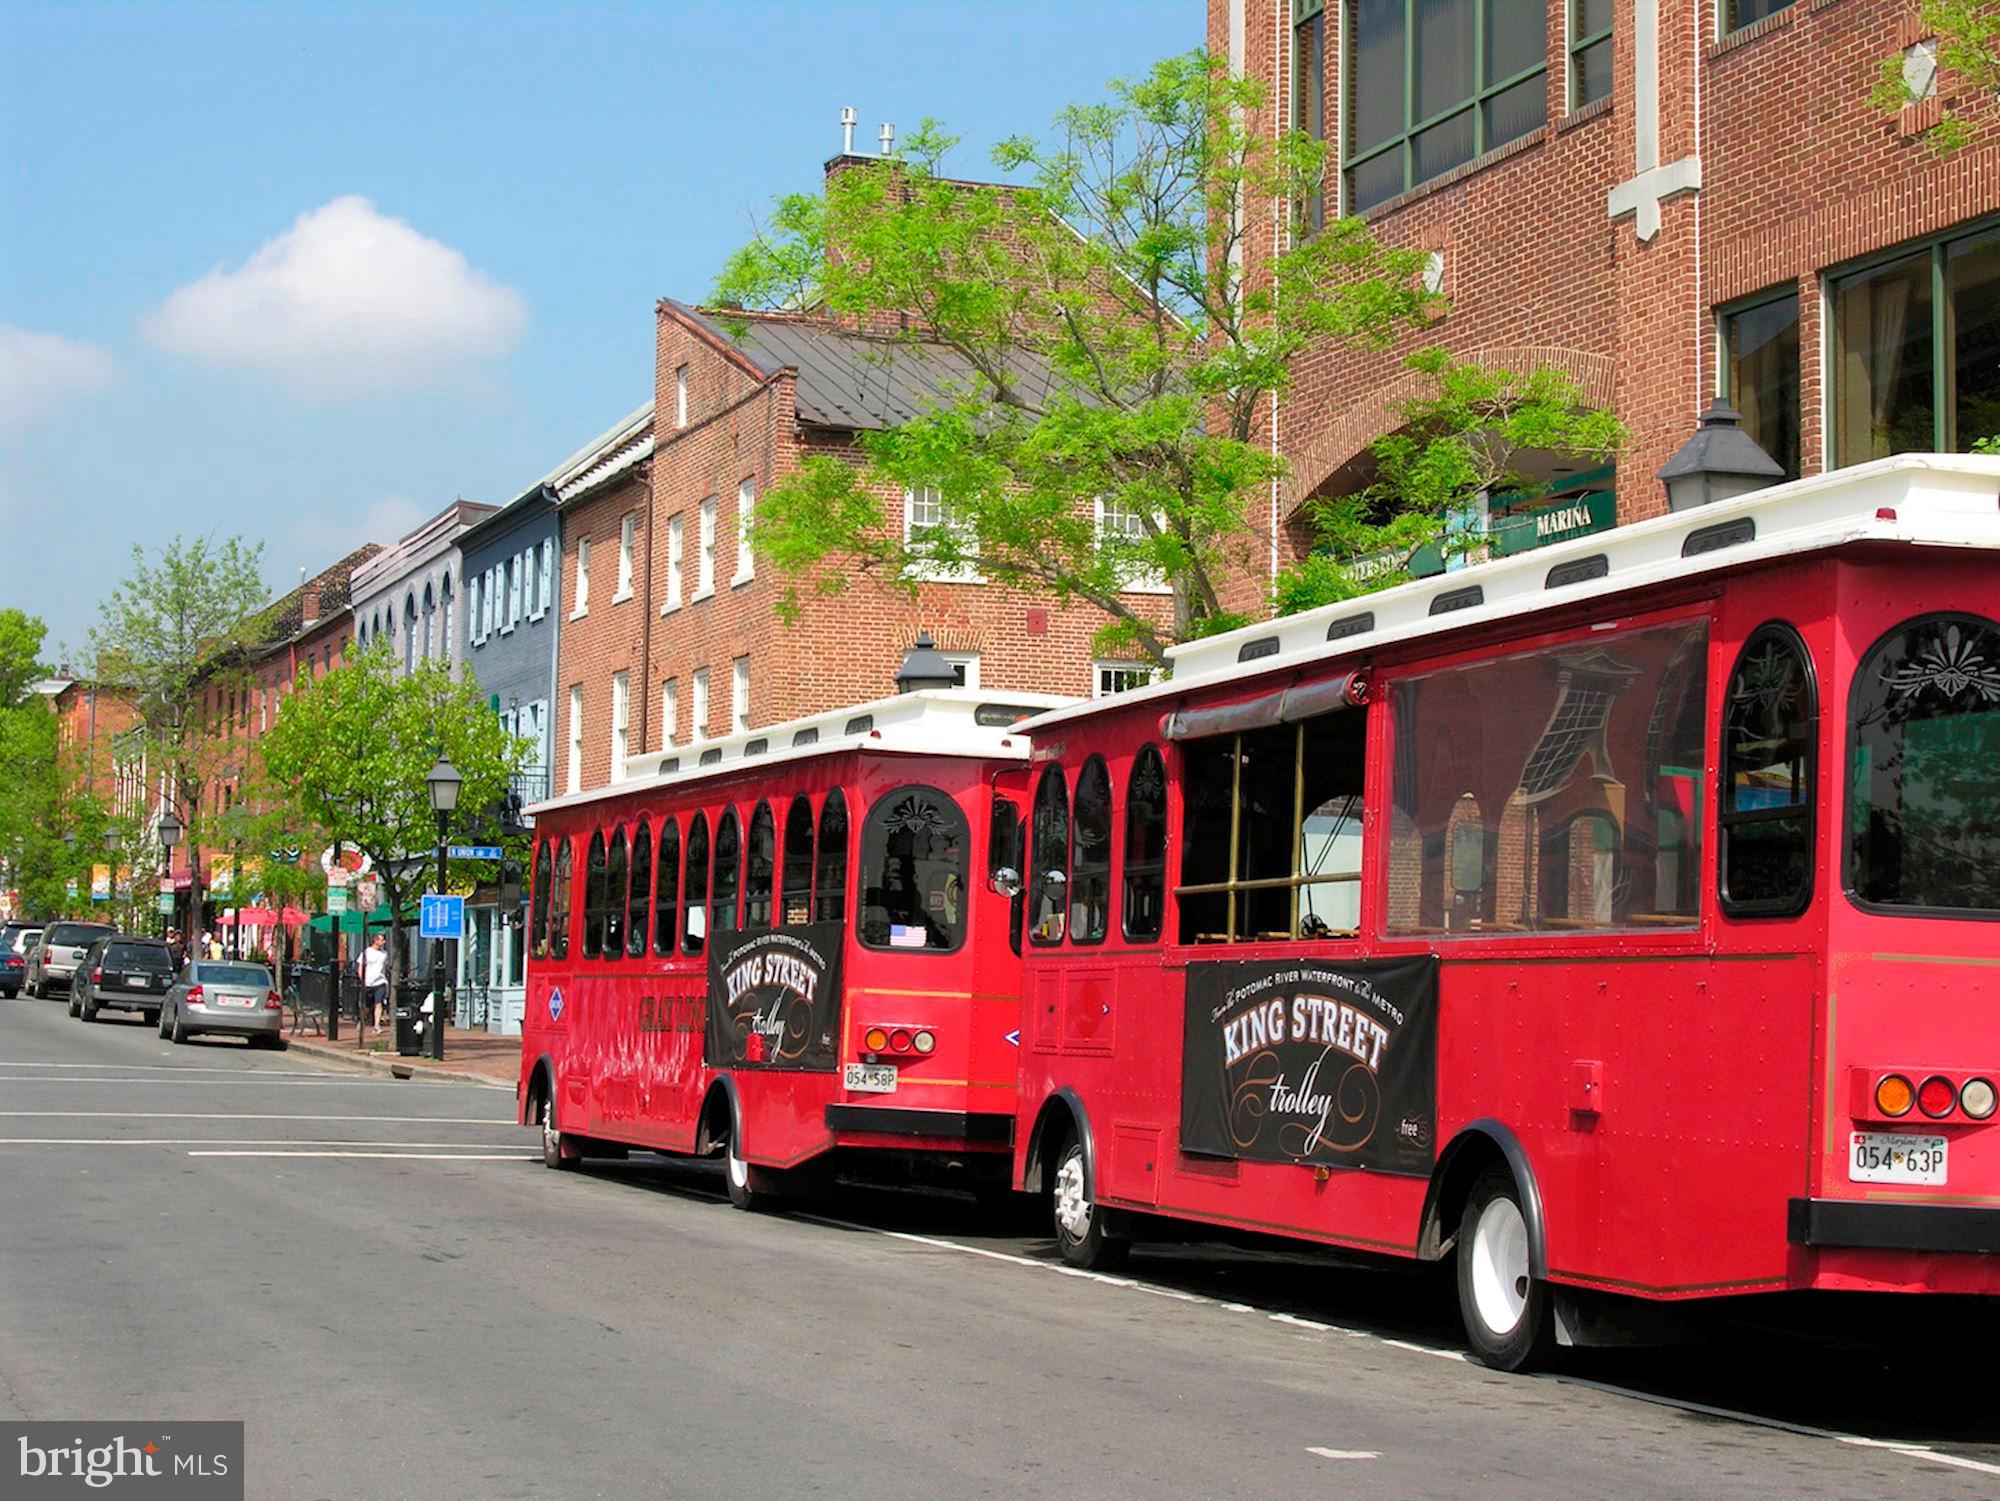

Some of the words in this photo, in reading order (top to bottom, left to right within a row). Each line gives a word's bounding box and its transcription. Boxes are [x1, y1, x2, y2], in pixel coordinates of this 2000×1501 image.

[1537, 504, 1592, 537] MARINA
[733, 940, 757, 959] POTOMAC
[757, 935, 770, 946] RIVER
[770, 934, 801, 947] WATERFRONT
[809, 948, 826, 970] METRO
[727, 955, 763, 1004] KING
[764, 953, 818, 1003] STREET
[639, 996, 674, 1032] GRAY
[676, 996, 708, 1032] LIN
[1235, 975, 1273, 1003] POTOMAC
[1274, 969, 1300, 985] RIVER
[1300, 969, 1355, 992] WATERFRONT
[1371, 991, 1404, 1026] METRO
[751, 985, 787, 1064] trolley
[1223, 999, 1285, 1064] KING
[1291, 997, 1389, 1071] STREET
[847, 1071, 867, 1085] 054
[874, 1072, 895, 1087] 58P
[1269, 1044, 1334, 1157] trolley
[1401, 1118, 1419, 1137] free
[1880, 1135, 1918, 1147] Maryland
[1856, 1145, 1893, 1170] 054
[1906, 1148, 1943, 1173] 63P
